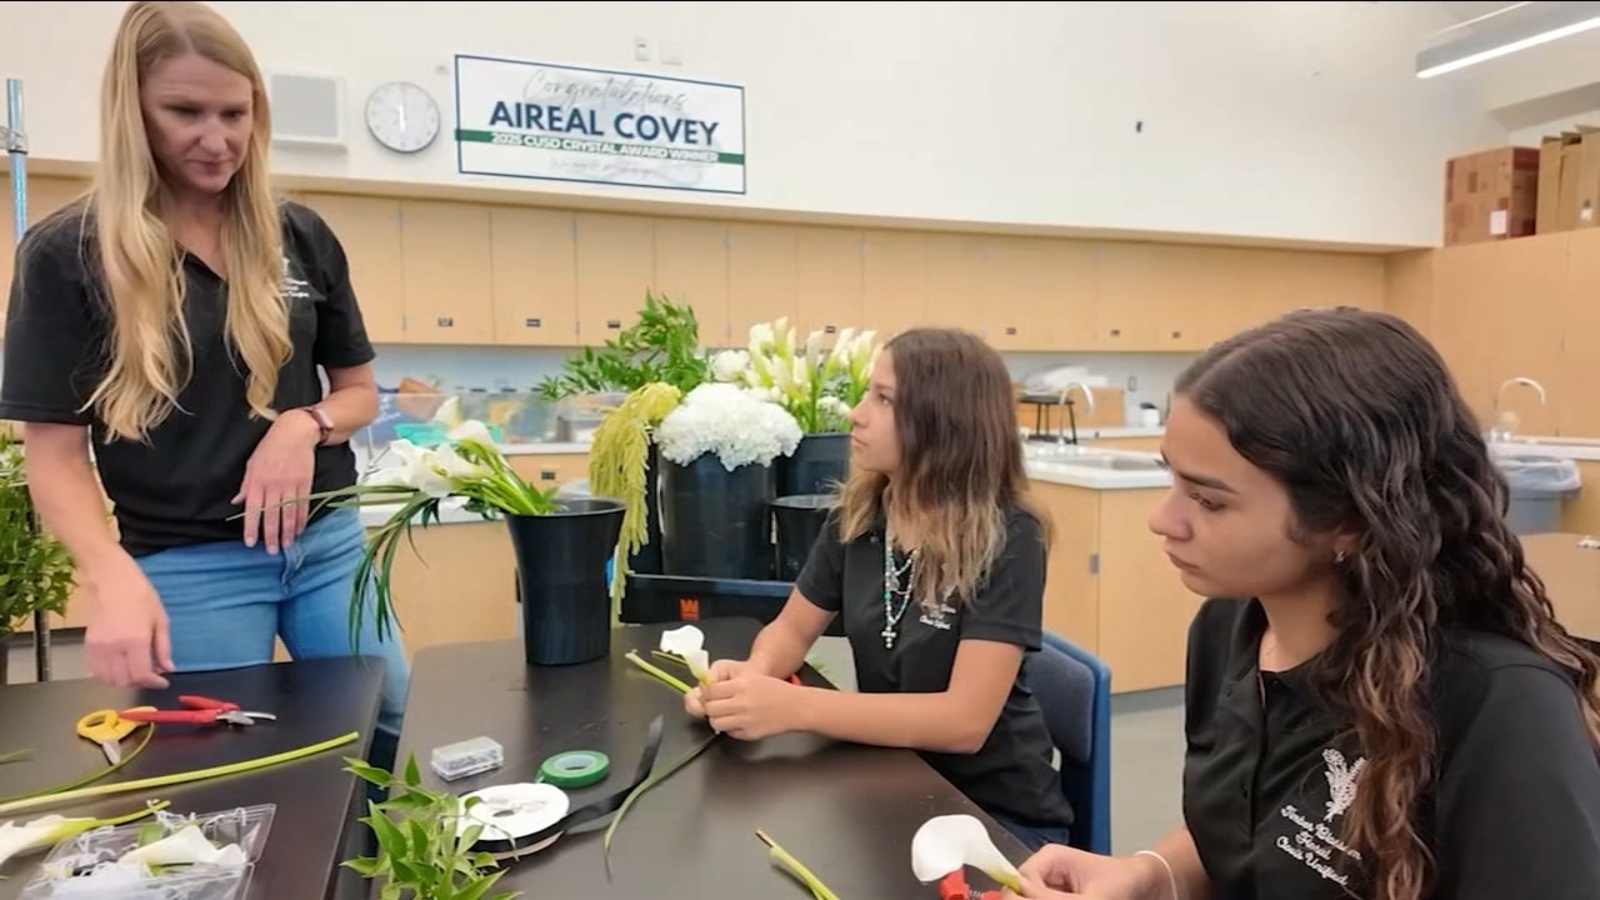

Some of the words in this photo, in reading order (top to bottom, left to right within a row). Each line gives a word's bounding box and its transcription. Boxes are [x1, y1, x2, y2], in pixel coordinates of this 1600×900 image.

[489, 101, 604, 136] AIREAL
[613, 112, 718, 146] COVEY
[562, 139, 617, 155] CRYSTAL
[618, 143, 668, 159] AWARD
[669, 148, 719, 163] WINNER
[1304, 852, 1348, 887] Unified
